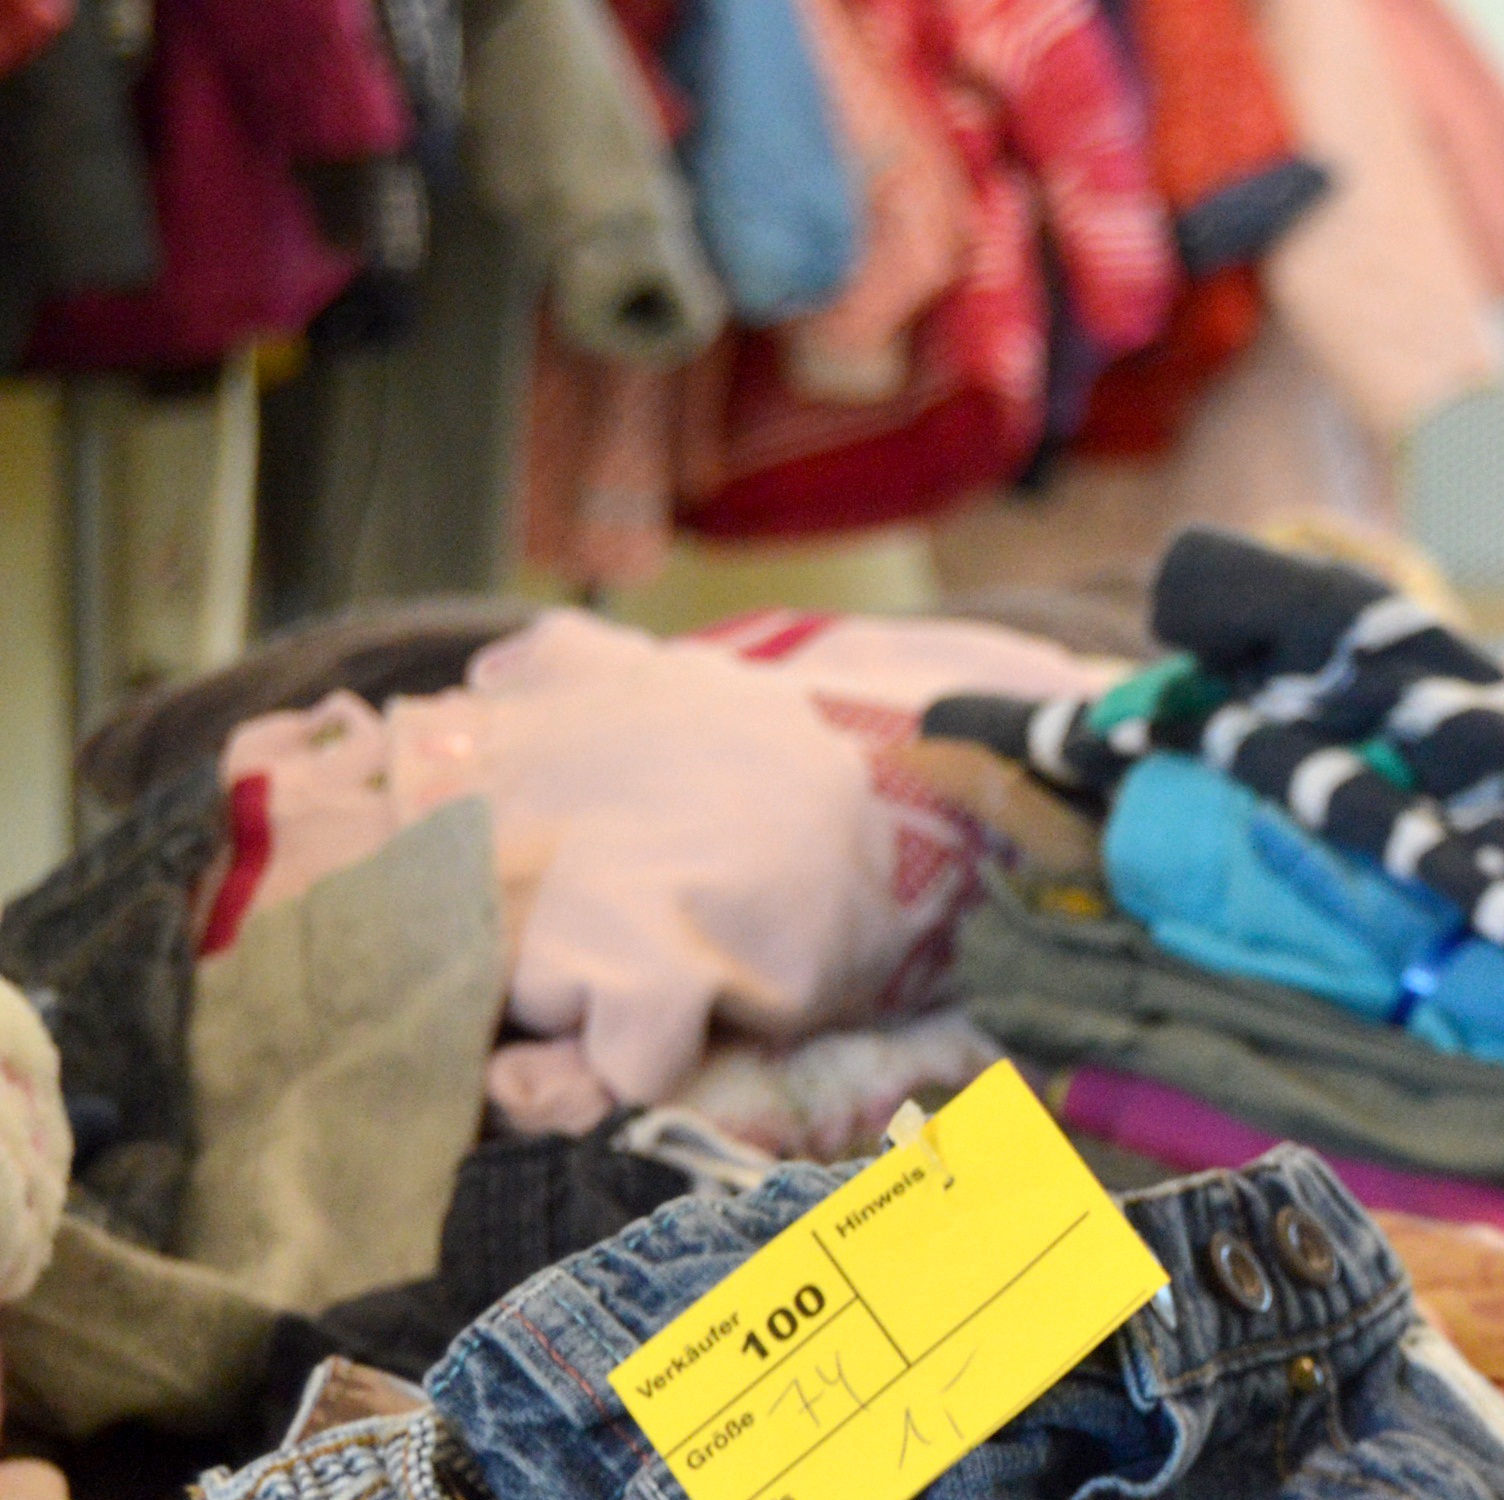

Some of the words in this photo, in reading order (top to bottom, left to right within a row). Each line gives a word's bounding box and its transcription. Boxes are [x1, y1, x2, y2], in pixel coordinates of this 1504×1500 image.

[835, 1167, 926, 1238] Hinweis
[636, 1311, 741, 1399] Verkäufer
[741, 1284, 826, 1361] 100
[686, 1411, 755, 1471] Größe
